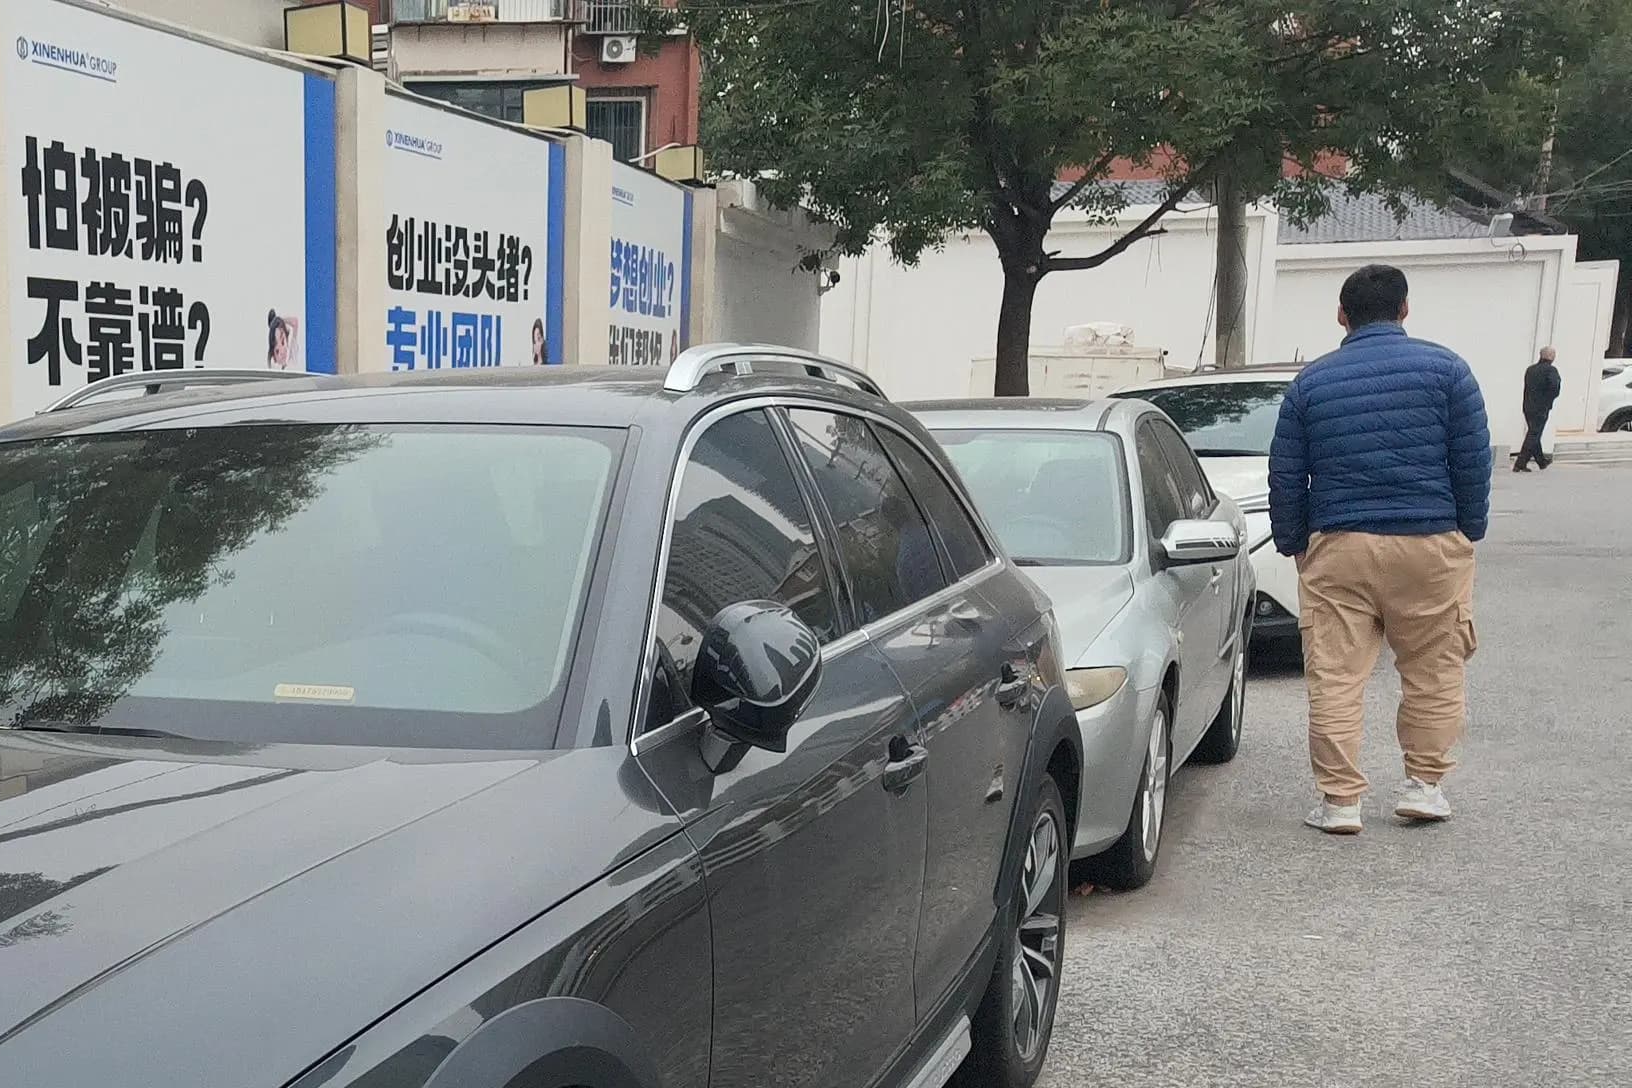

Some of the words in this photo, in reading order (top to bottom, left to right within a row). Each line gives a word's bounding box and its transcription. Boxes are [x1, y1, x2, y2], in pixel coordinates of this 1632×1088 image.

[31, 40, 87, 69] XINENHUA
[89, 55, 117, 77] GROUP
[21, 135, 209, 264] 怕被骗?
[386, 213, 532, 303] 创业没头绪?
[26, 276, 211, 386] 不靠谱?
[386, 306, 502, 372] 专业团队
